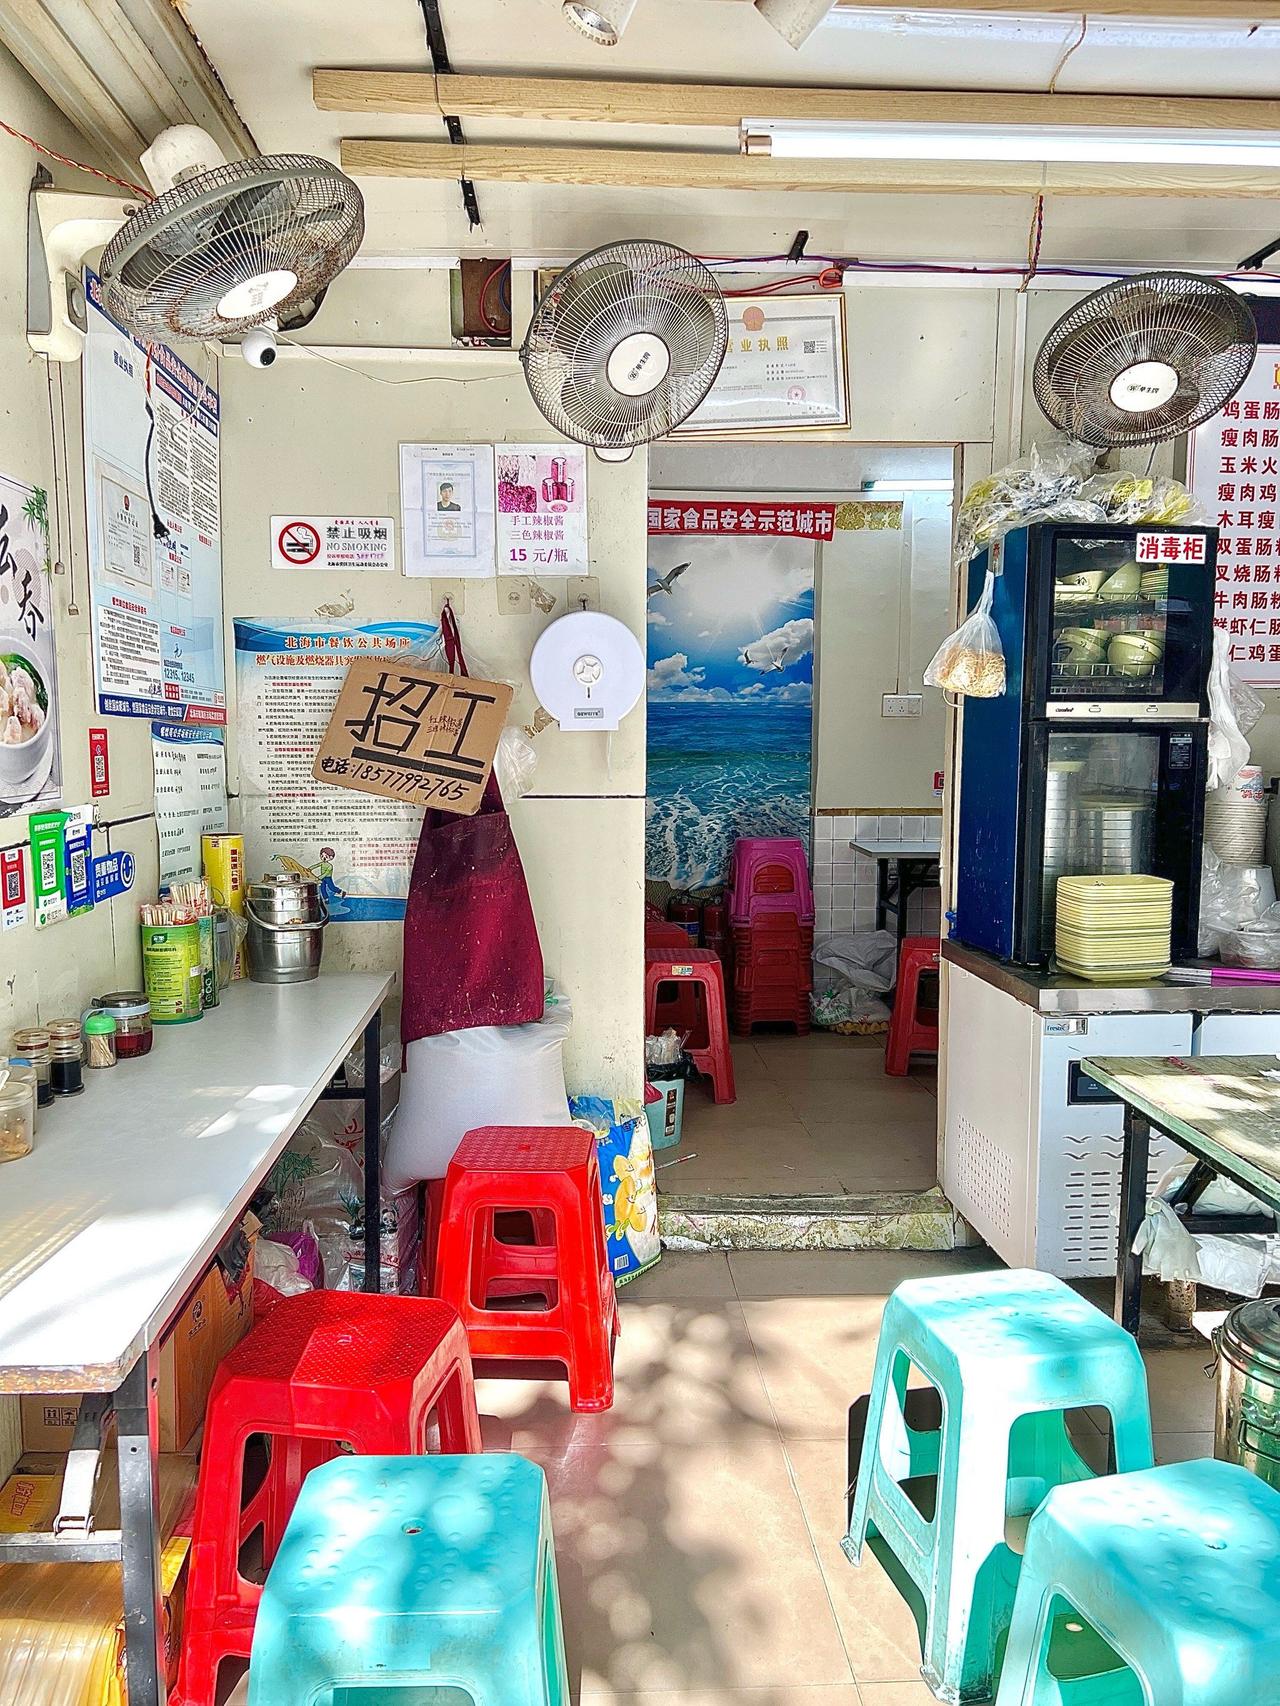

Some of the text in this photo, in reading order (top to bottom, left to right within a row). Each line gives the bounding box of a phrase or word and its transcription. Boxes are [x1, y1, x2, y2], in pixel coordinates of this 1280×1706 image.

[1221, 428, 1279, 447] 瘦肉肠
[1219, 456, 1278, 475] 玉米火
[1218, 483, 1277, 502] 瘦肉鸡
[510, 515, 564, 526] 手工辣椒酱
[648, 506, 832, 535] 国家食品安全示范城市
[1217, 510, 1276, 529] 木耳瘦
[326, 525, 388, 540] 禁止吸烟
[510, 530, 564, 541] 三色辣椒酱
[327, 543, 387, 552] NO SMOKING
[510, 548, 568, 563] 15 元/瓶
[1139, 536, 1203, 560] 消毒柜
[1217, 538, 1280, 556] 双蛋肠
[285, 637, 411, 649] 北海市餐饮公共场所
[344, 672, 497, 769] 招工
